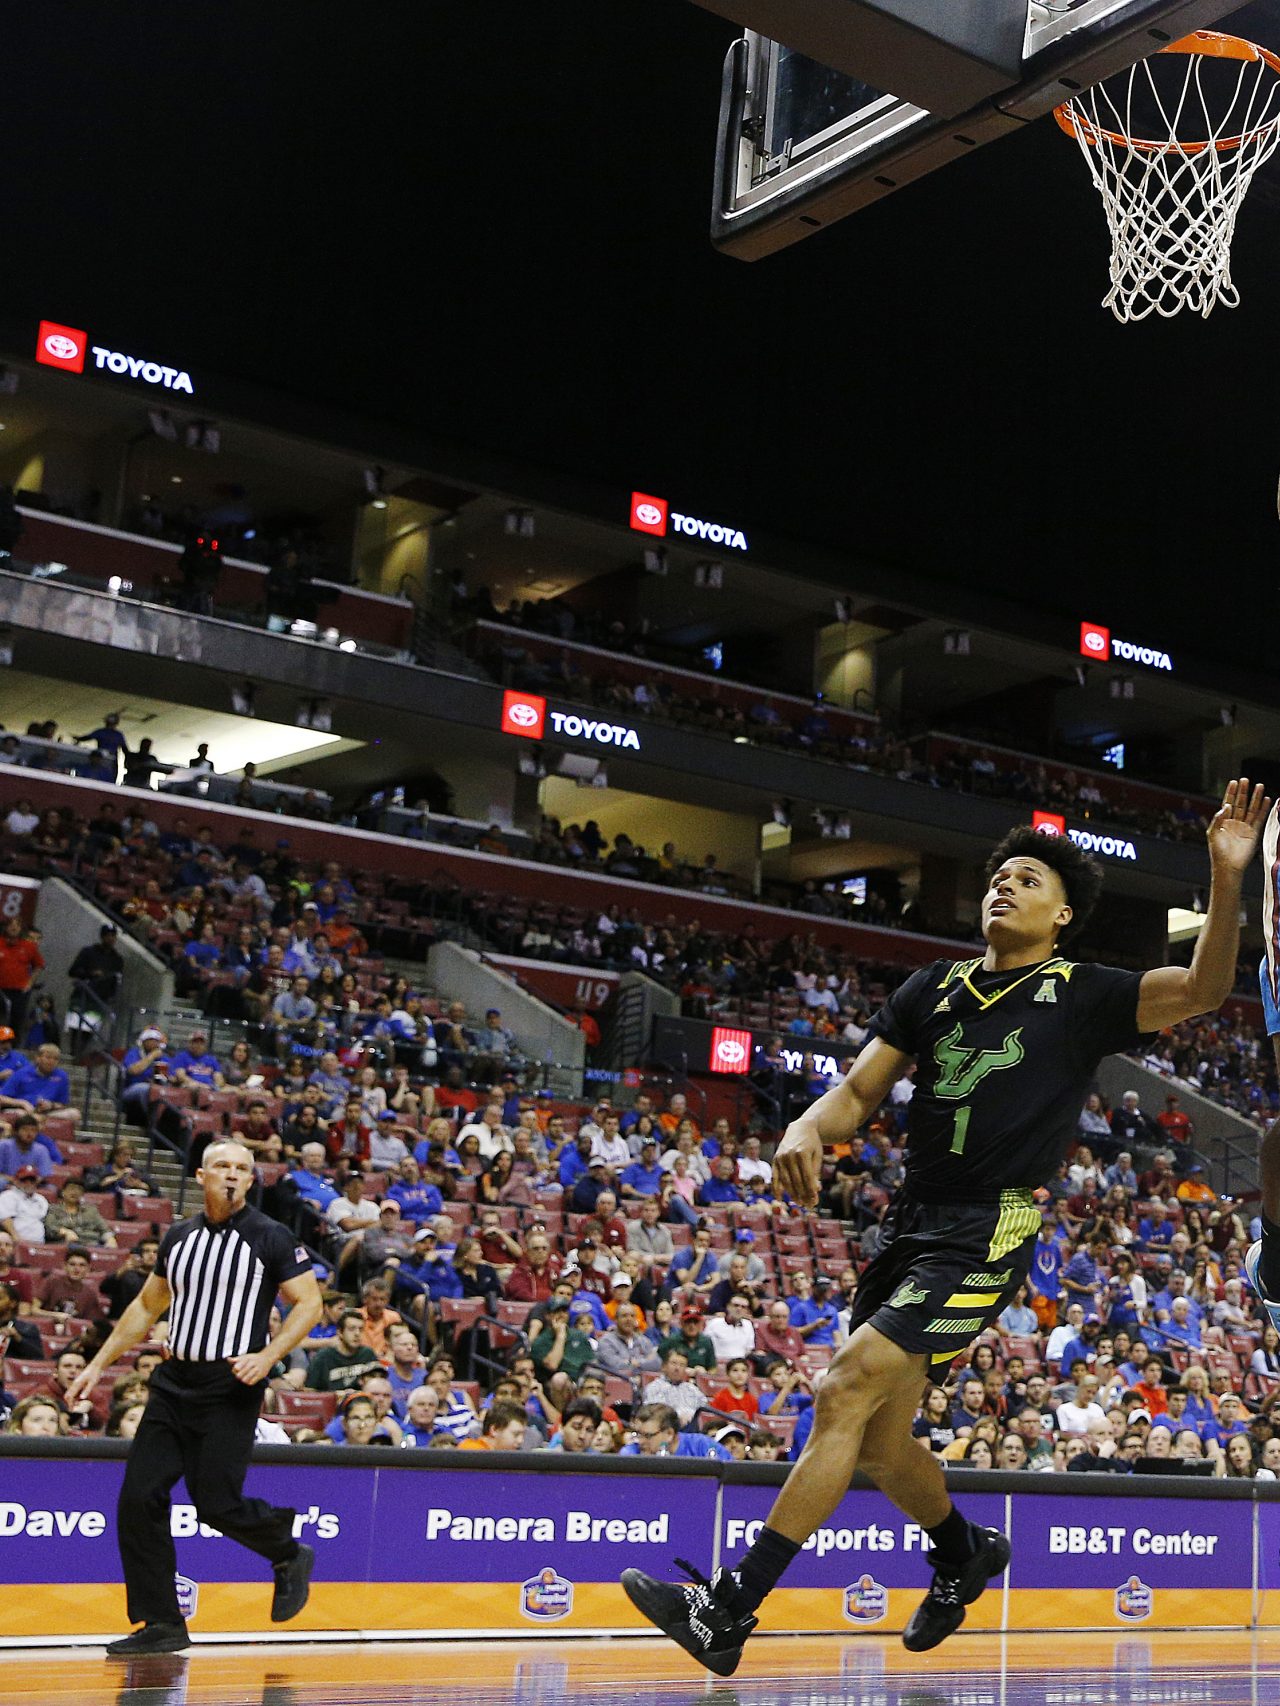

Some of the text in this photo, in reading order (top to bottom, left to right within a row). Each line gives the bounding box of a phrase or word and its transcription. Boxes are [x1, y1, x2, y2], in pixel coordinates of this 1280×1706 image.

[91, 346, 194, 394] TOYOTA
[670, 512, 748, 550] TOYOTA
[1111, 639, 1173, 671] TOYOTA
[550, 711, 641, 750] TOYOTA
[1067, 828, 1137, 861] TOYOTA
[949, 1105, 972, 1155] 1
[0, 1502, 106, 1538] Dave
[425, 1508, 669, 1544] Panera Bread
[726, 1518, 768, 1549] FO
[1049, 1526, 1219, 1556] BB&T Center
